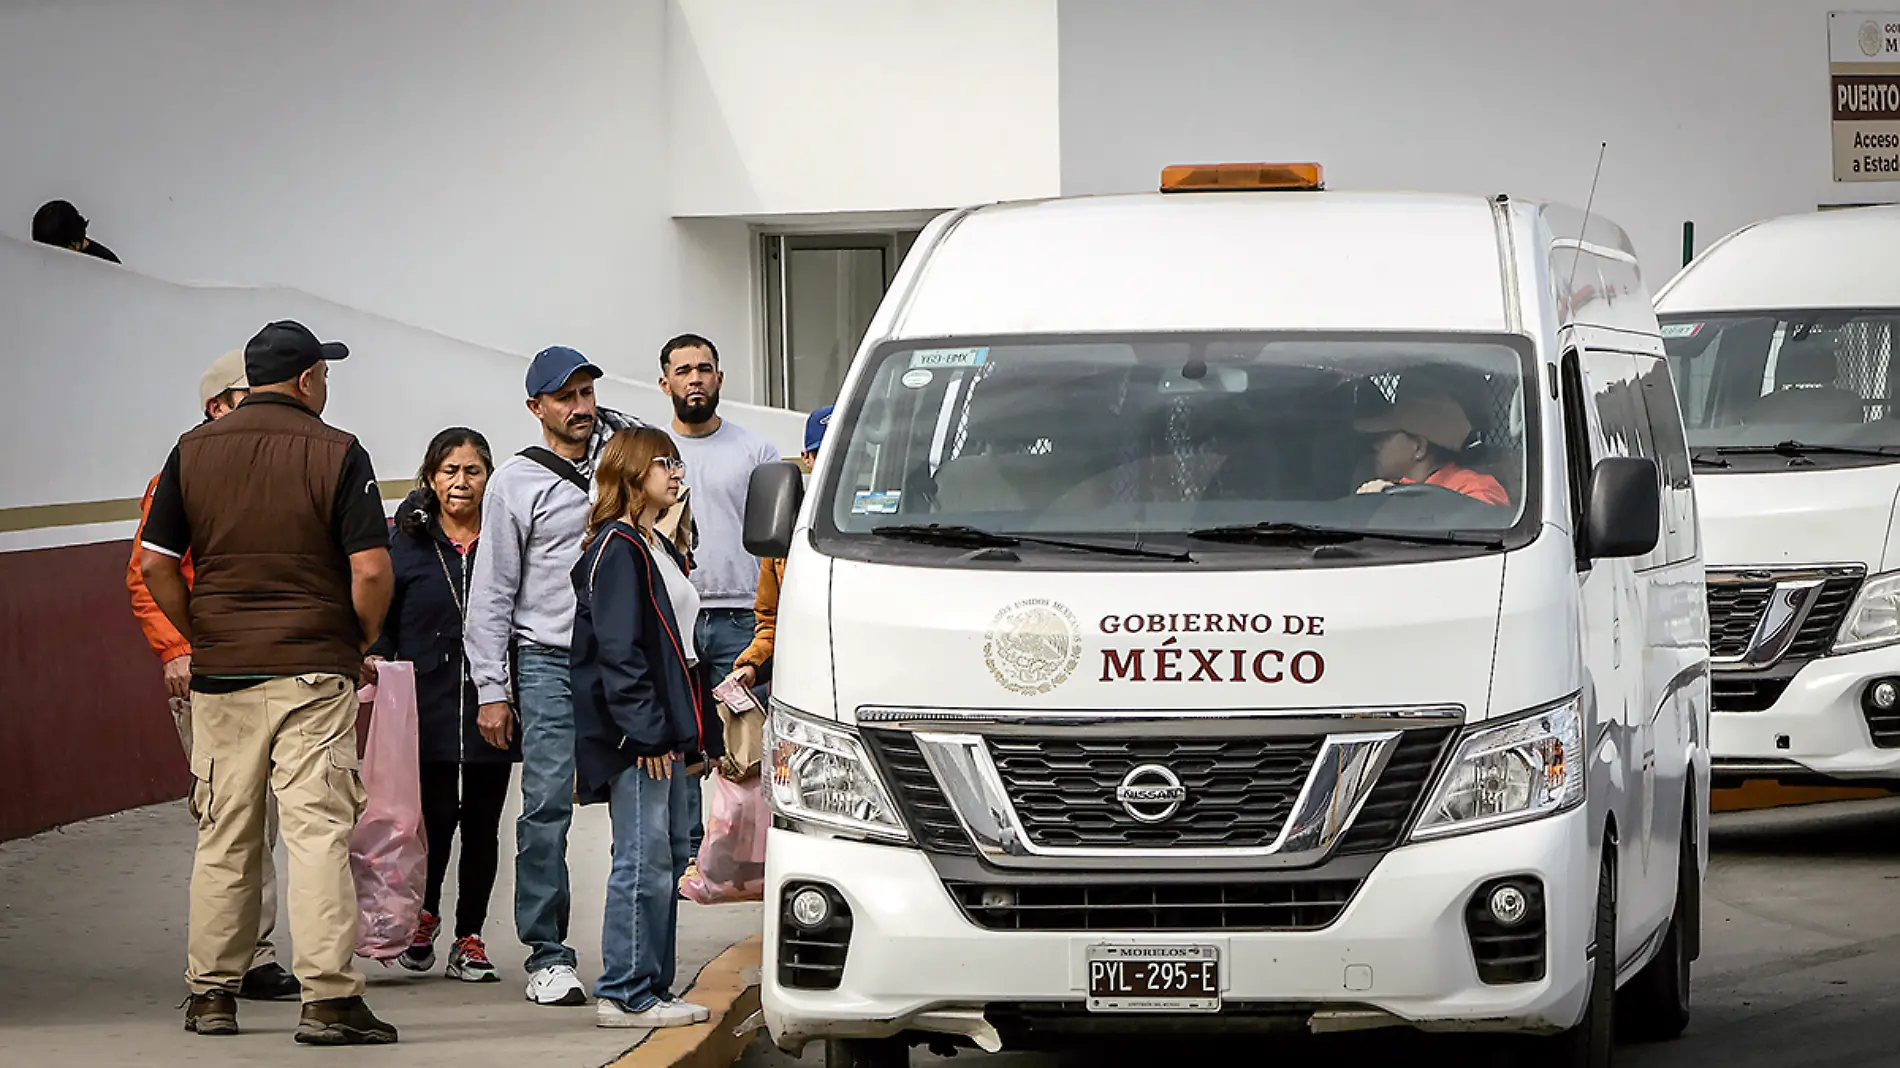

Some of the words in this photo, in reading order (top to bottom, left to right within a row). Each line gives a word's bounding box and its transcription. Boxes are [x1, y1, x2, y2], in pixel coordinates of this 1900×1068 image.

[1884, 23, 1900, 33] GO
[1837, 84, 1899, 112] PUERTO
[1854, 131, 1899, 148] Acceso
[1853, 160, 1860, 172] a
[1099, 613, 1272, 634] GOBIERNO
[1283, 615, 1325, 636] DE
[1099, 636, 1325, 684] MÉXICO
[1124, 789, 1178, 800] NISSAN
[1120, 948, 1187, 957] MORELOS
[1091, 961, 1215, 991] PYL-295-E
